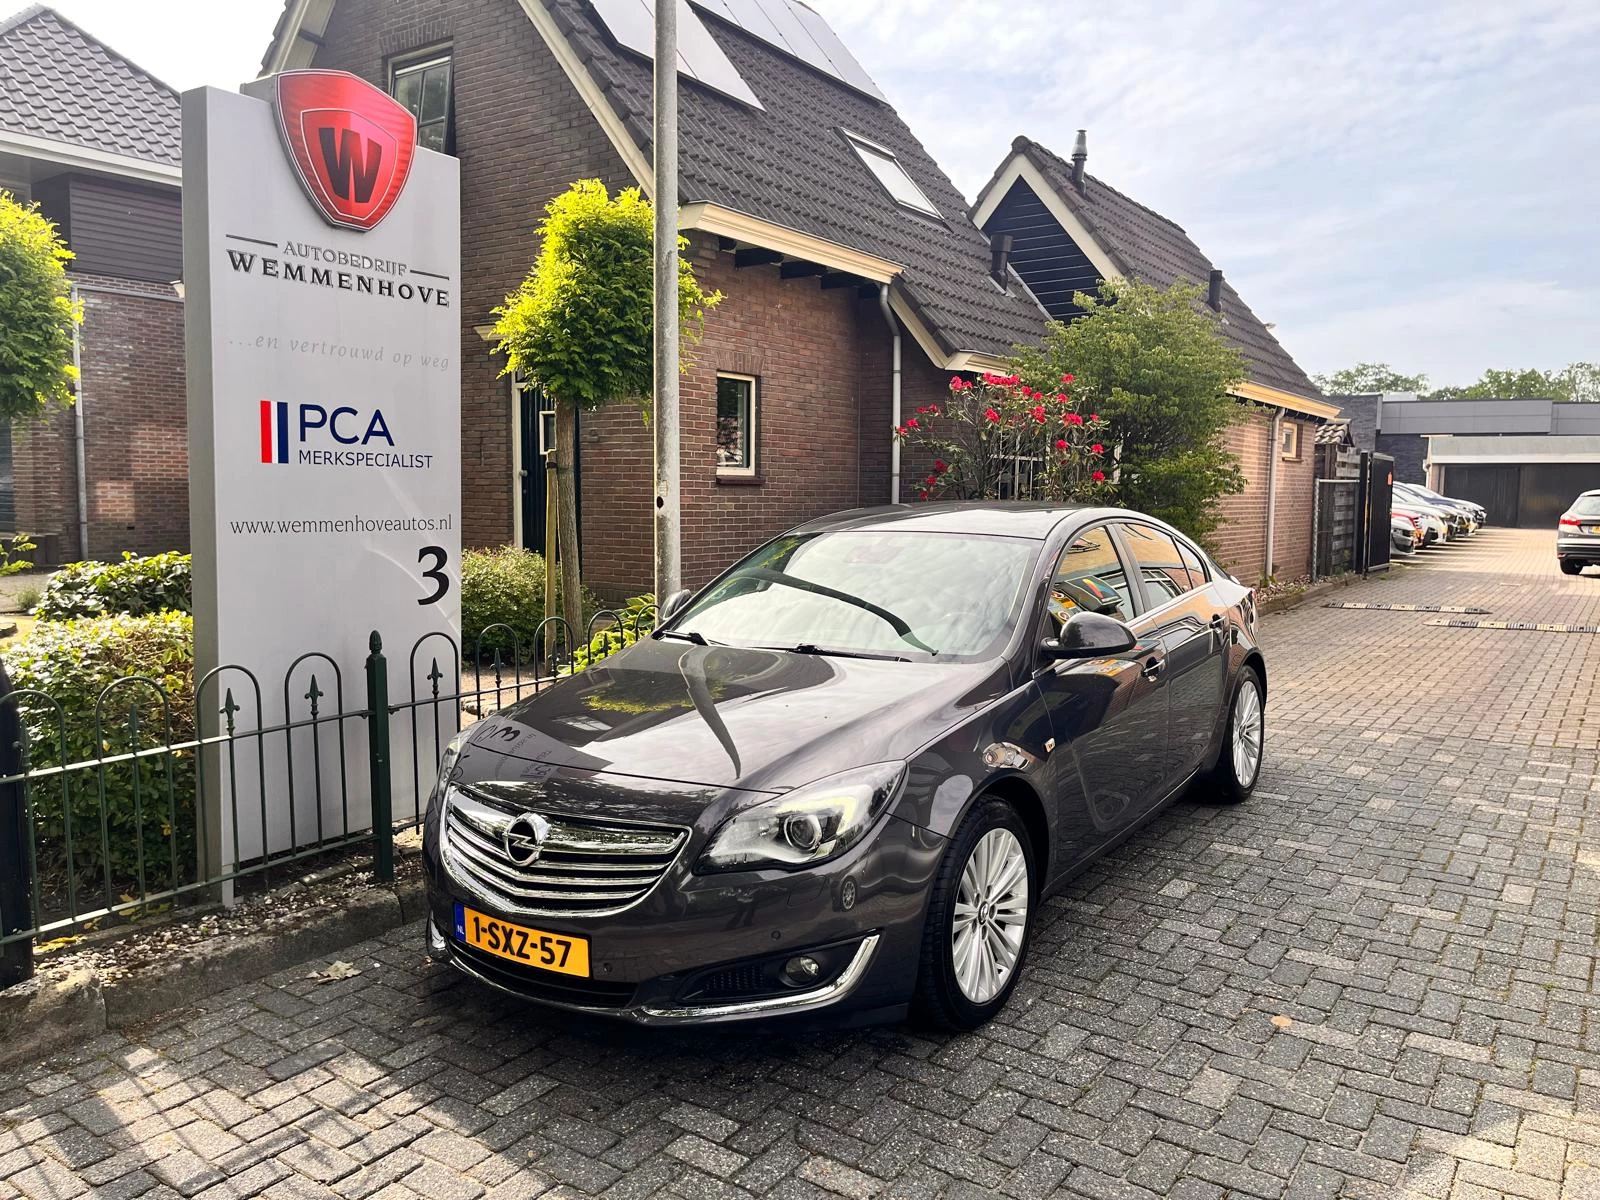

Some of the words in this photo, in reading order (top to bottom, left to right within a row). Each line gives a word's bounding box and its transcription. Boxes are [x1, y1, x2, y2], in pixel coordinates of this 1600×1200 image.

[318, 127, 383, 204] W
[226, 249, 450, 307] WEMMENHOVE
[283, 241, 407, 276] AUTOBEDRIJF
[290, 338, 384, 361] vertrouwd
[392, 352, 412, 367] op
[421, 354, 449, 371] weg
[299, 403, 395, 447] PCA
[299, 450, 433, 469] MERKSPECIALIST
[230, 514, 453, 534] www.wemmenhoveautos.nl
[417, 545, 450, 606] 3
[473, 916, 572, 968] 1-SXZ-57
